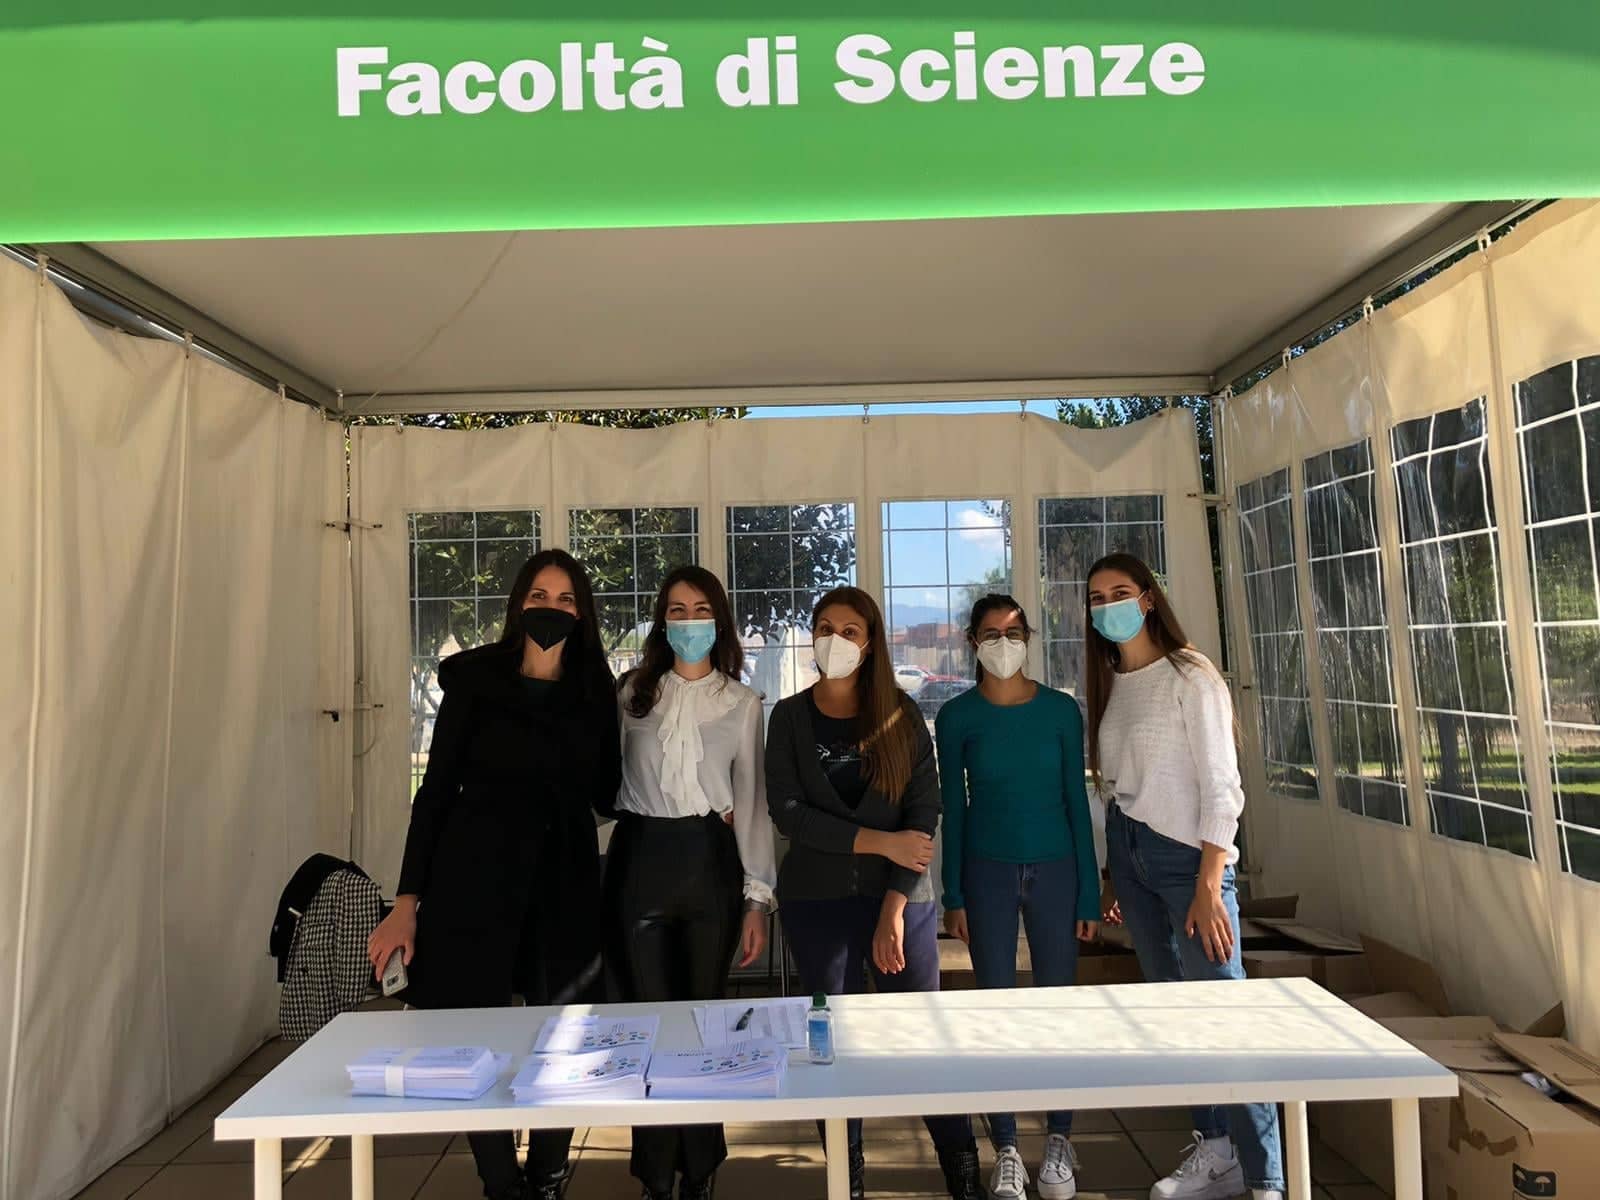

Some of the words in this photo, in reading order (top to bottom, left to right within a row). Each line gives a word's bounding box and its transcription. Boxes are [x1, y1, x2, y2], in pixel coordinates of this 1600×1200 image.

[336, 37, 684, 118] Facoltà
[715, 35, 799, 108] di
[834, 31, 1206, 105] Scienze
